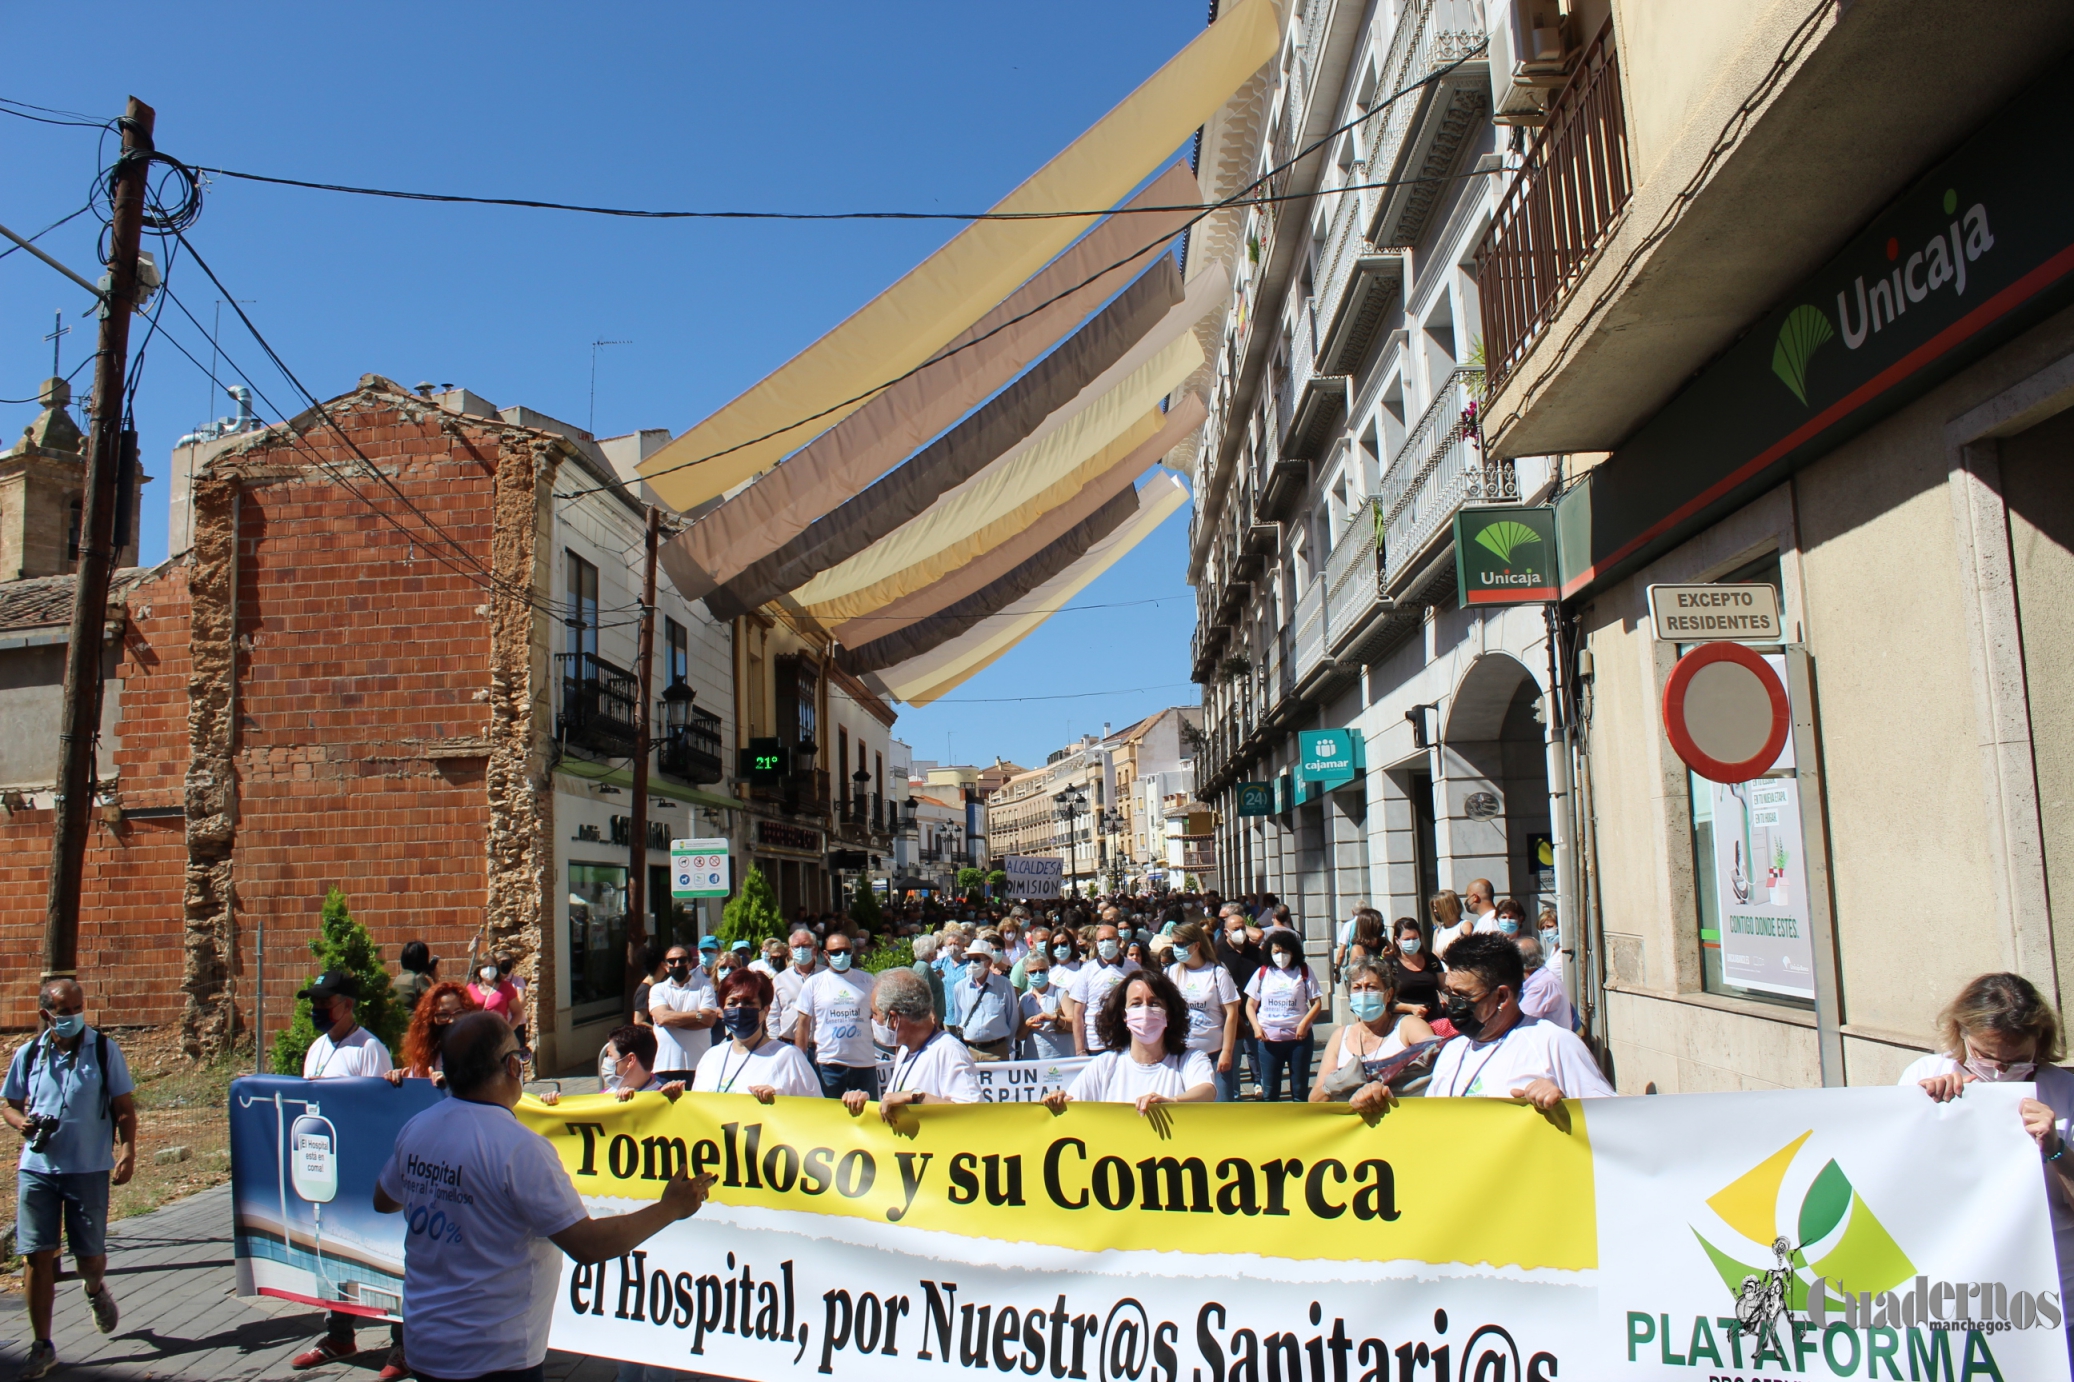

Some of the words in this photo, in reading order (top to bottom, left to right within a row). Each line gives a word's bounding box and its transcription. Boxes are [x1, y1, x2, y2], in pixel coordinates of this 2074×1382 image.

[1837, 188, 1995, 350] Unicaja
[1481, 568, 1542, 587] Unicaja
[1677, 592, 1753, 608] EXCEPTO
[1667, 615, 1771, 630] RESIDENTES
[1305, 760, 1349, 772] cajamar
[1006, 860, 1063, 876] ALCALDESA
[1007, 877, 1059, 895] DIMISIÓN
[1729, 914, 1754, 935] CONTIGO
[1755, 916, 1776, 937] DONDE
[1776, 914, 1800, 939] ESTÉS.
[1268, 998, 1297, 1009] Hospital
[830, 1008, 861, 1018] Hospital
[1008, 1068, 1038, 1085] UN
[308, 1140, 329, 1152] Hospital
[407, 1153, 463, 1187] Hospital
[565, 1122, 877, 1198] Tomelloso
[886, 1152, 933, 1222] y
[947, 1152, 1026, 1207] su
[1043, 1137, 1402, 1222] Comarca
[434, 1183, 474, 1205] Tomelloso
[570, 1258, 606, 1317] el
[615, 1251, 809, 1366] Hospital,
[818, 1289, 910, 1375] por
[917, 1280, 1178, 1382] Nuestr@s
[1625, 1308, 2005, 1382] PLATAFORMA
